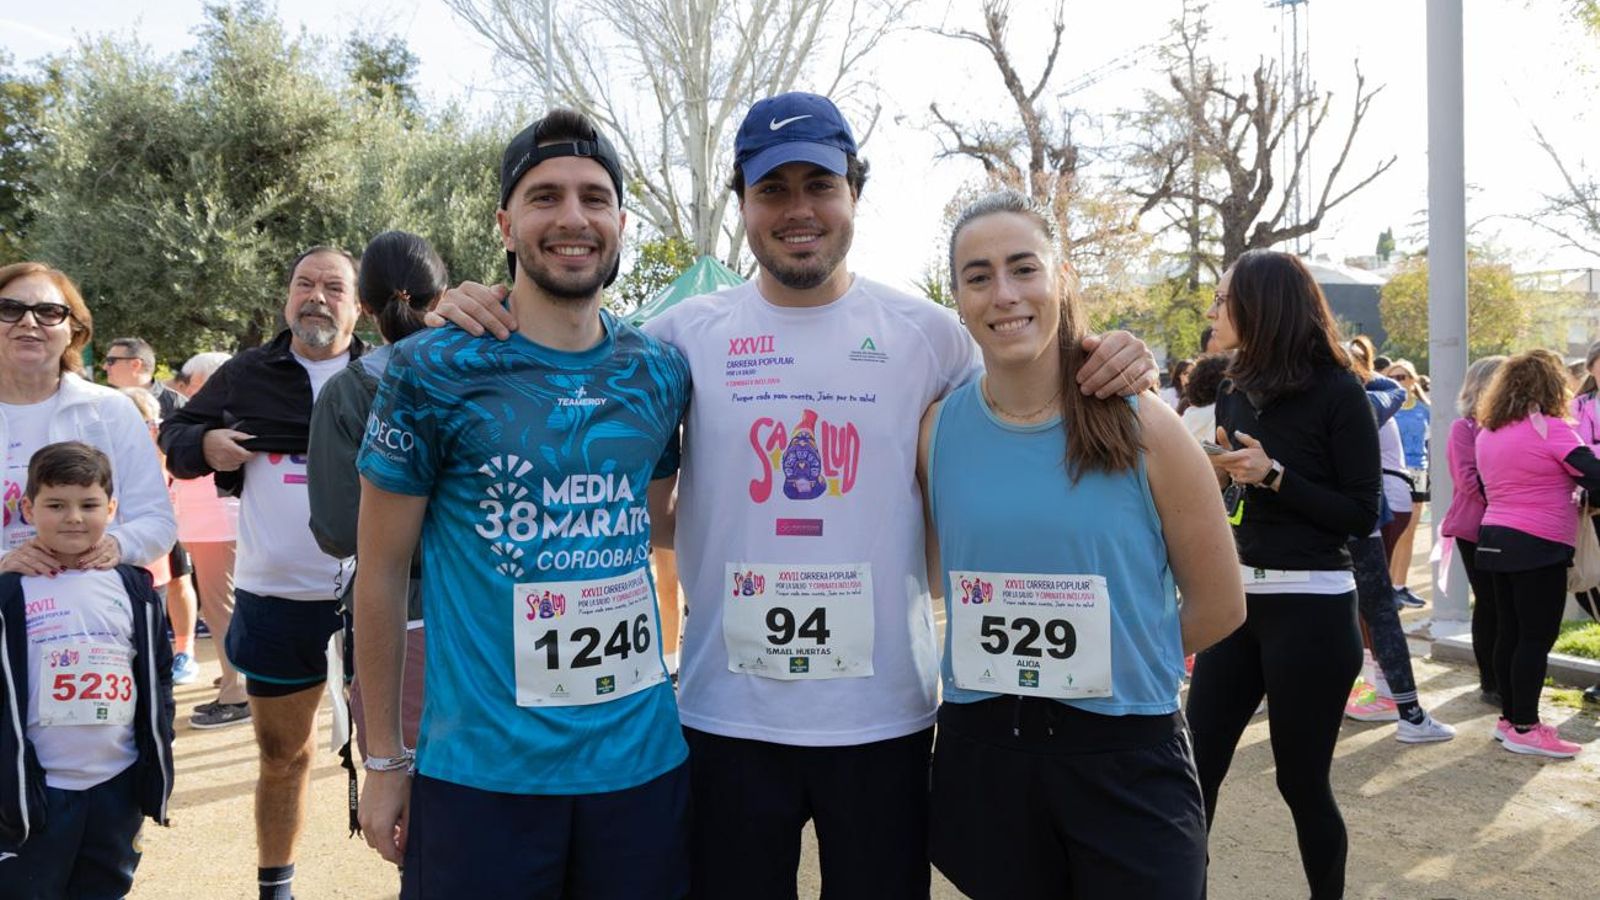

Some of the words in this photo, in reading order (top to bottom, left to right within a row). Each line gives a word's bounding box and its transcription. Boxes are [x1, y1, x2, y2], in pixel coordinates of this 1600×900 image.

[728, 335, 775, 356] XXVII
[726, 359, 758, 369] CARRERA
[758, 357, 795, 366] POPULAR
[557, 398, 608, 406] TEAMERGY
[859, 394, 876, 403] salud
[543, 473, 634, 506] MEDIA
[474, 500, 538, 542] 38
[537, 547, 633, 571] CORDOBA
[778, 571, 799, 581] XXVII
[800, 571, 828, 581] CARRERA
[1005, 579, 1025, 590] XXVII
[1026, 580, 1055, 590] CARRERA
[1056, 580, 1090, 590] POPULAR
[581, 586, 603, 599] XXVII
[766, 607, 830, 645] 94
[534, 613, 651, 670] 1246
[980, 615, 1077, 660] 529
[1016, 659, 1041, 668] ALICIA
[52, 672, 132, 702] 5233
